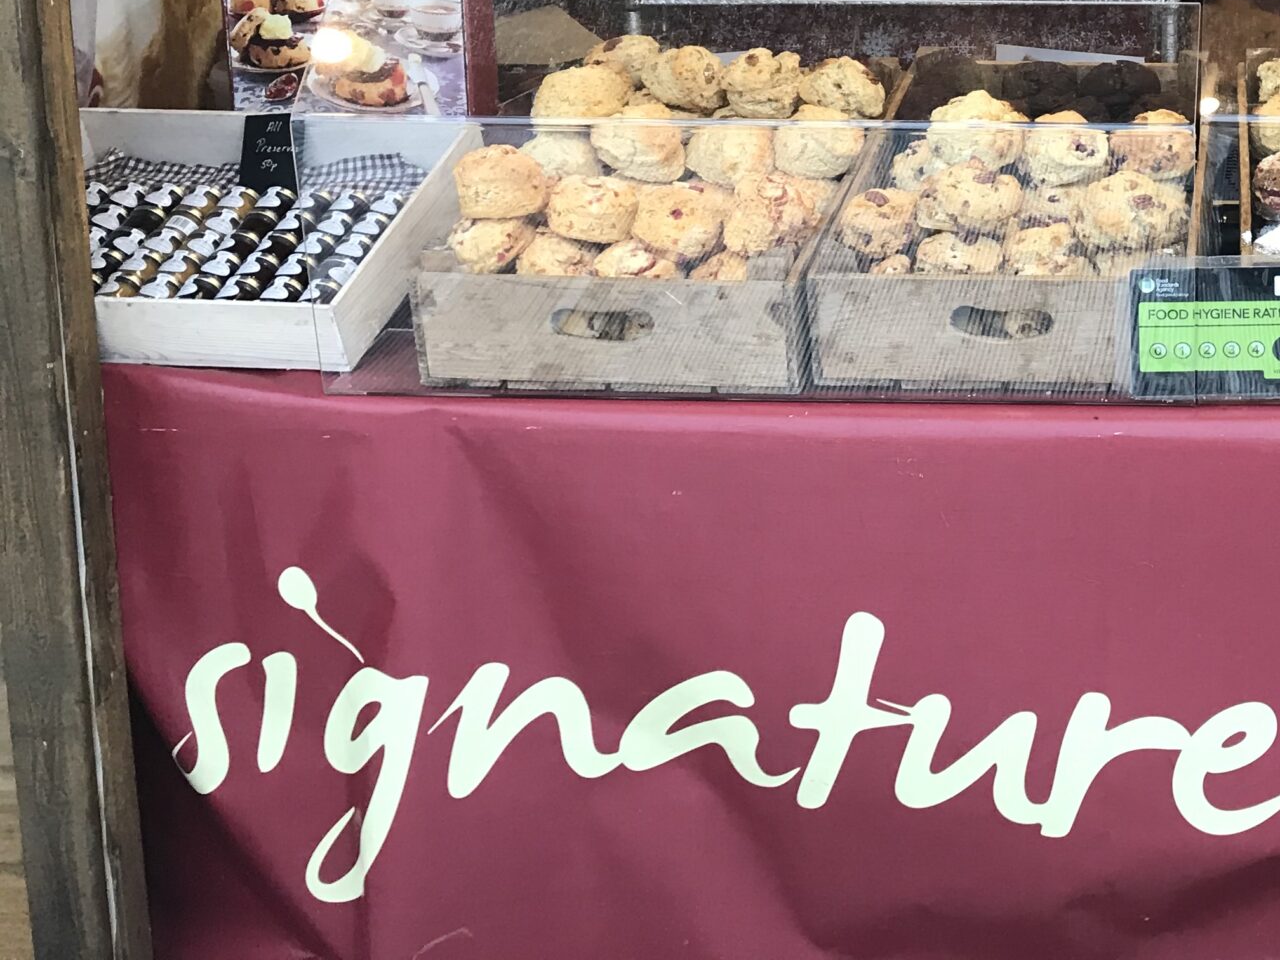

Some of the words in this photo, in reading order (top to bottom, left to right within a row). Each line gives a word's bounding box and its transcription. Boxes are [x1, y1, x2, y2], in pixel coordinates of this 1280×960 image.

[265, 120, 283, 132] All
[260, 158, 278, 172] 50p
[1147, 308, 1189, 321] FOOD
[1192, 307, 1251, 320] HYGIENE
[1203, 345, 1211, 355] 2
[1227, 344, 1236, 355] 3
[1251, 344, 1260, 355] 4
